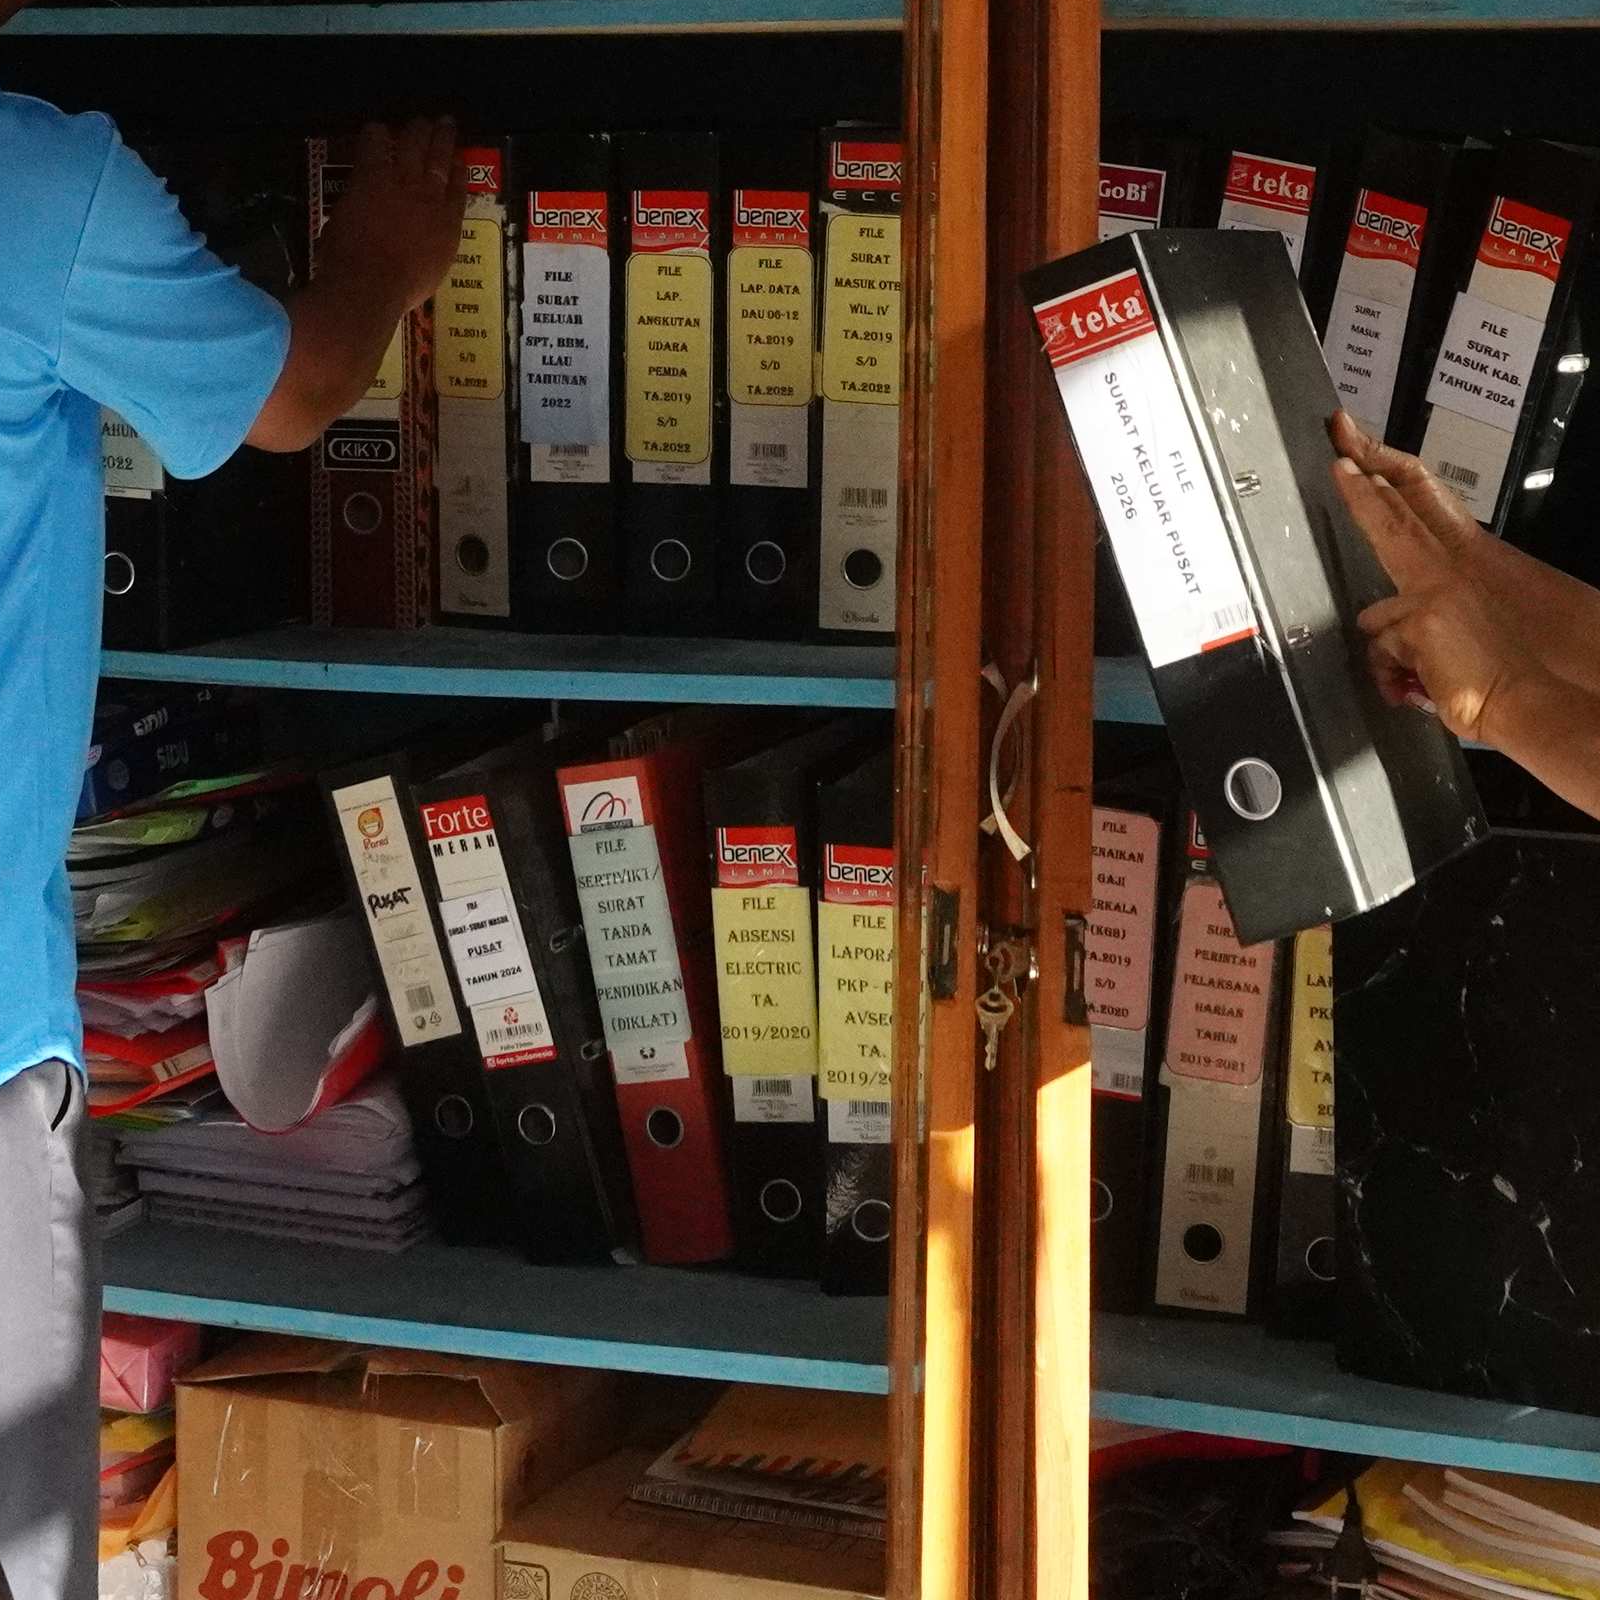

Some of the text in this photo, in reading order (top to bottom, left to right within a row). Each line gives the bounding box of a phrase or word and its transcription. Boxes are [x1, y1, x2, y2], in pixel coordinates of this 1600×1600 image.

[832, 141, 902, 183] benex
[1252, 170, 1309, 201] teka
[529, 191, 608, 233] benex
[632, 189, 710, 233] benex
[735, 189, 809, 232] benex
[1355, 188, 1424, 250] benex
[859, 227, 885, 239] FILE
[1488, 195, 1563, 264] benex
[758, 259, 783, 270] FILE
[850, 253, 891, 264] SURAT
[544, 271, 573, 283] FILE
[657, 266, 683, 277] FILE
[451, 279, 484, 290] MASUK
[768, 284, 801, 296] DATA
[834, 277, 876, 289] MASUK
[536, 294, 579, 306] SURAT
[656, 291, 683, 301] LAP.
[741, 308, 765, 319] DAU
[849, 304, 890, 316] WIL. IV
[1071, 292, 1145, 340] teka
[1355, 304, 1381, 319] SURAT
[533, 312, 584, 325] KELUAR
[637, 315, 701, 328] ANGKUTAN
[842, 329, 893, 343] TA.2019
[1351, 324, 1380, 340] MASUK
[1480, 321, 1508, 338] FILE
[648, 341, 689, 353] UDARA
[747, 334, 794, 346] TA.2019
[1466, 340, 1511, 362] SURAT
[760, 360, 781, 371] S/D
[855, 356, 878, 368] S/D
[1443, 350, 1522, 387] MASUK KAB.
[648, 366, 688, 377] PEMDA
[1343, 363, 1372, 378] TAHUN
[527, 373, 588, 386] TAHUNAN
[747, 384, 795, 396] TA.2022
[840, 381, 891, 394] TA.2022
[1438, 372, 1516, 409] TAHUN 2024
[541, 397, 572, 409] 2022
[643, 391, 692, 404] TA.2019
[656, 417, 678, 428] S/D
[340, 442, 383, 459] KIKY
[642, 440, 691, 453] TA.2022
[1168, 450, 1195, 494] FILE
[1104, 371, 1202, 596] SURAT KELUAR PUSAT
[1110, 473, 1138, 521] 2026
[423, 805, 489, 836] Forte
[1102, 821, 1128, 833] FILE
[596, 839, 627, 854] FILE
[718, 827, 797, 868] benex
[1092, 846, 1145, 863] ENAIKAN
[826, 843, 893, 886] benex
[1096, 873, 1125, 887] GAJI
[598, 896, 646, 914] SURAT
[742, 897, 776, 910] FILE
[1092, 899, 1138, 915] ERKALA
[852, 914, 886, 929] FILE
[600, 923, 652, 941] TANDA
[728, 929, 795, 943] ABSENSI
[467, 941, 502, 958] PUSAT
[832, 945, 893, 962] LAPORA
[605, 949, 658, 968] TAMAT
[1086, 951, 1132, 967] A.2019
[1195, 949, 1257, 968] PERINTAH
[465, 965, 522, 985] TAHUN 2024
[725, 962, 801, 975] ELECTRIC
[597, 978, 683, 1001] PENDIDIKAN
[837, 978, 868, 993] PKP
[1095, 978, 1116, 990] S/D
[1183, 973, 1260, 995] PELAKSANA
[751, 994, 778, 1007] TA.
[1087, 1002, 1129, 1018] A.2020
[1195, 1002, 1244, 1018] HARIAN
[611, 1011, 678, 1033] (DIKLAT)
[722, 1025, 811, 1041] 2019/2020
[1195, 1028, 1238, 1043] TAHUN
[857, 1043, 886, 1058] TA.
[1180, 1052, 1246, 1072] 2019-2021
